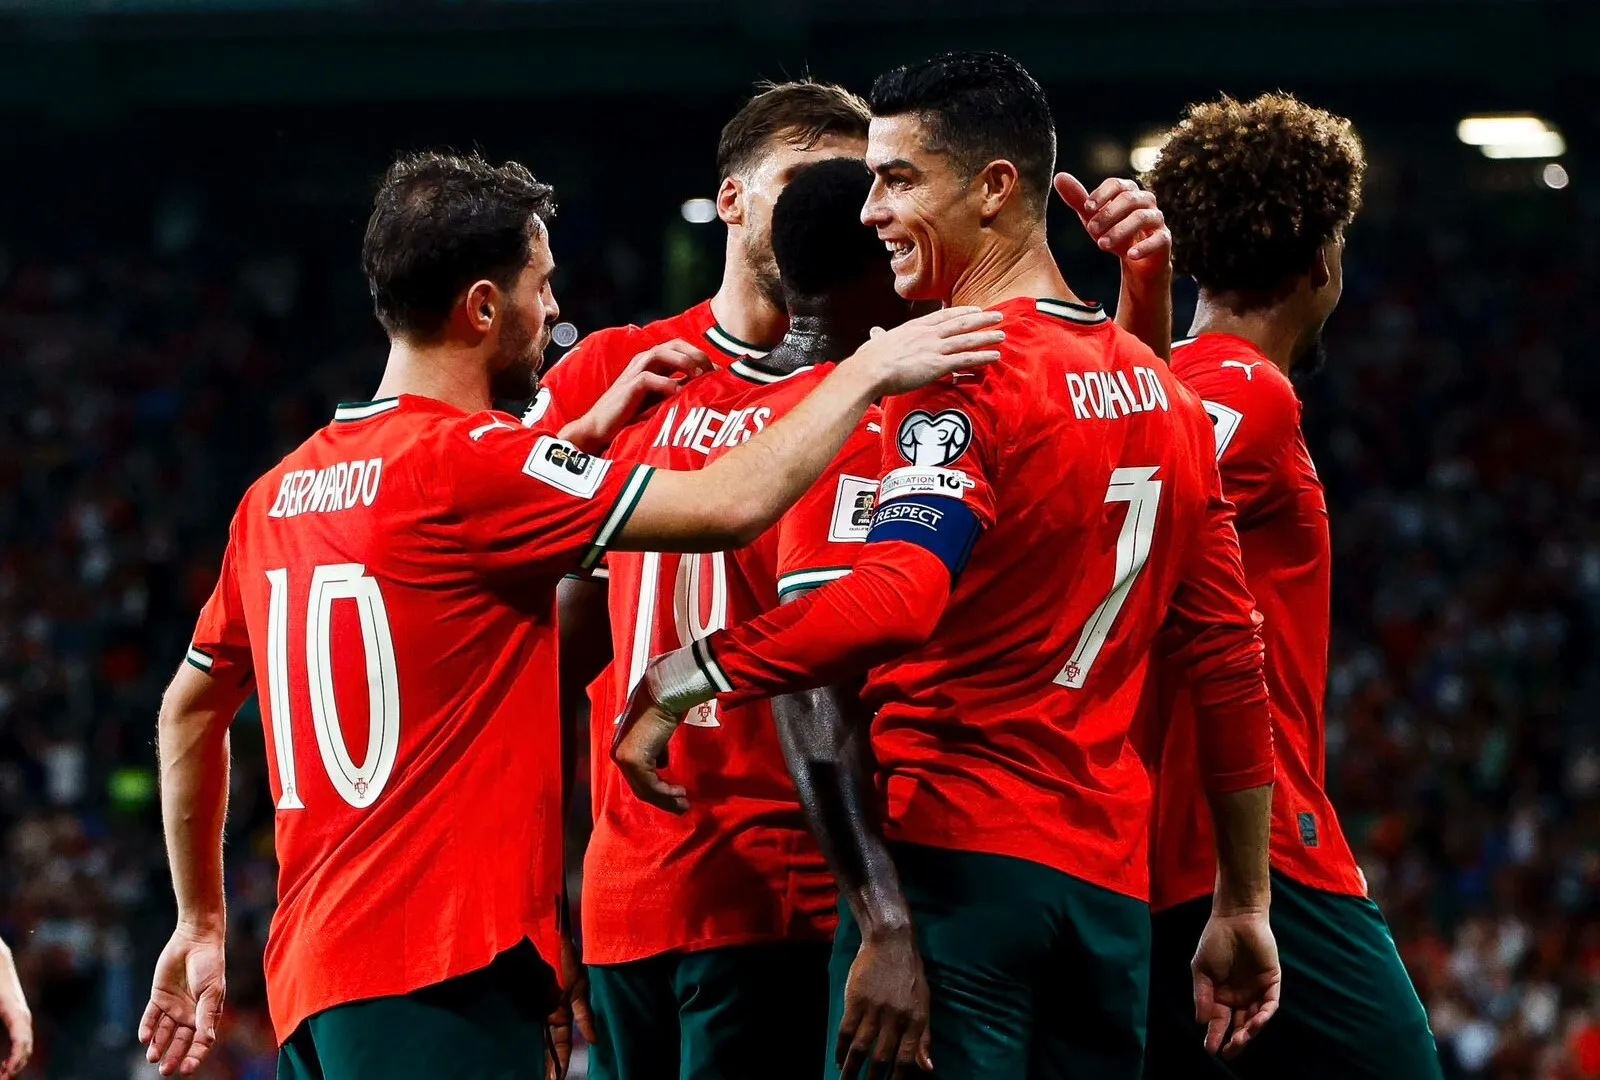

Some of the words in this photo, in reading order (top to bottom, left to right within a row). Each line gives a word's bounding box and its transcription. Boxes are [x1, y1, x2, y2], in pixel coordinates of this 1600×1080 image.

[1065, 366, 1169, 419] RONALDO
[267, 457, 383, 518] BERNARDO
[876, 506, 942, 526] RESPECT
[1052, 465, 1163, 690] 7
[265, 563, 400, 809] 10
